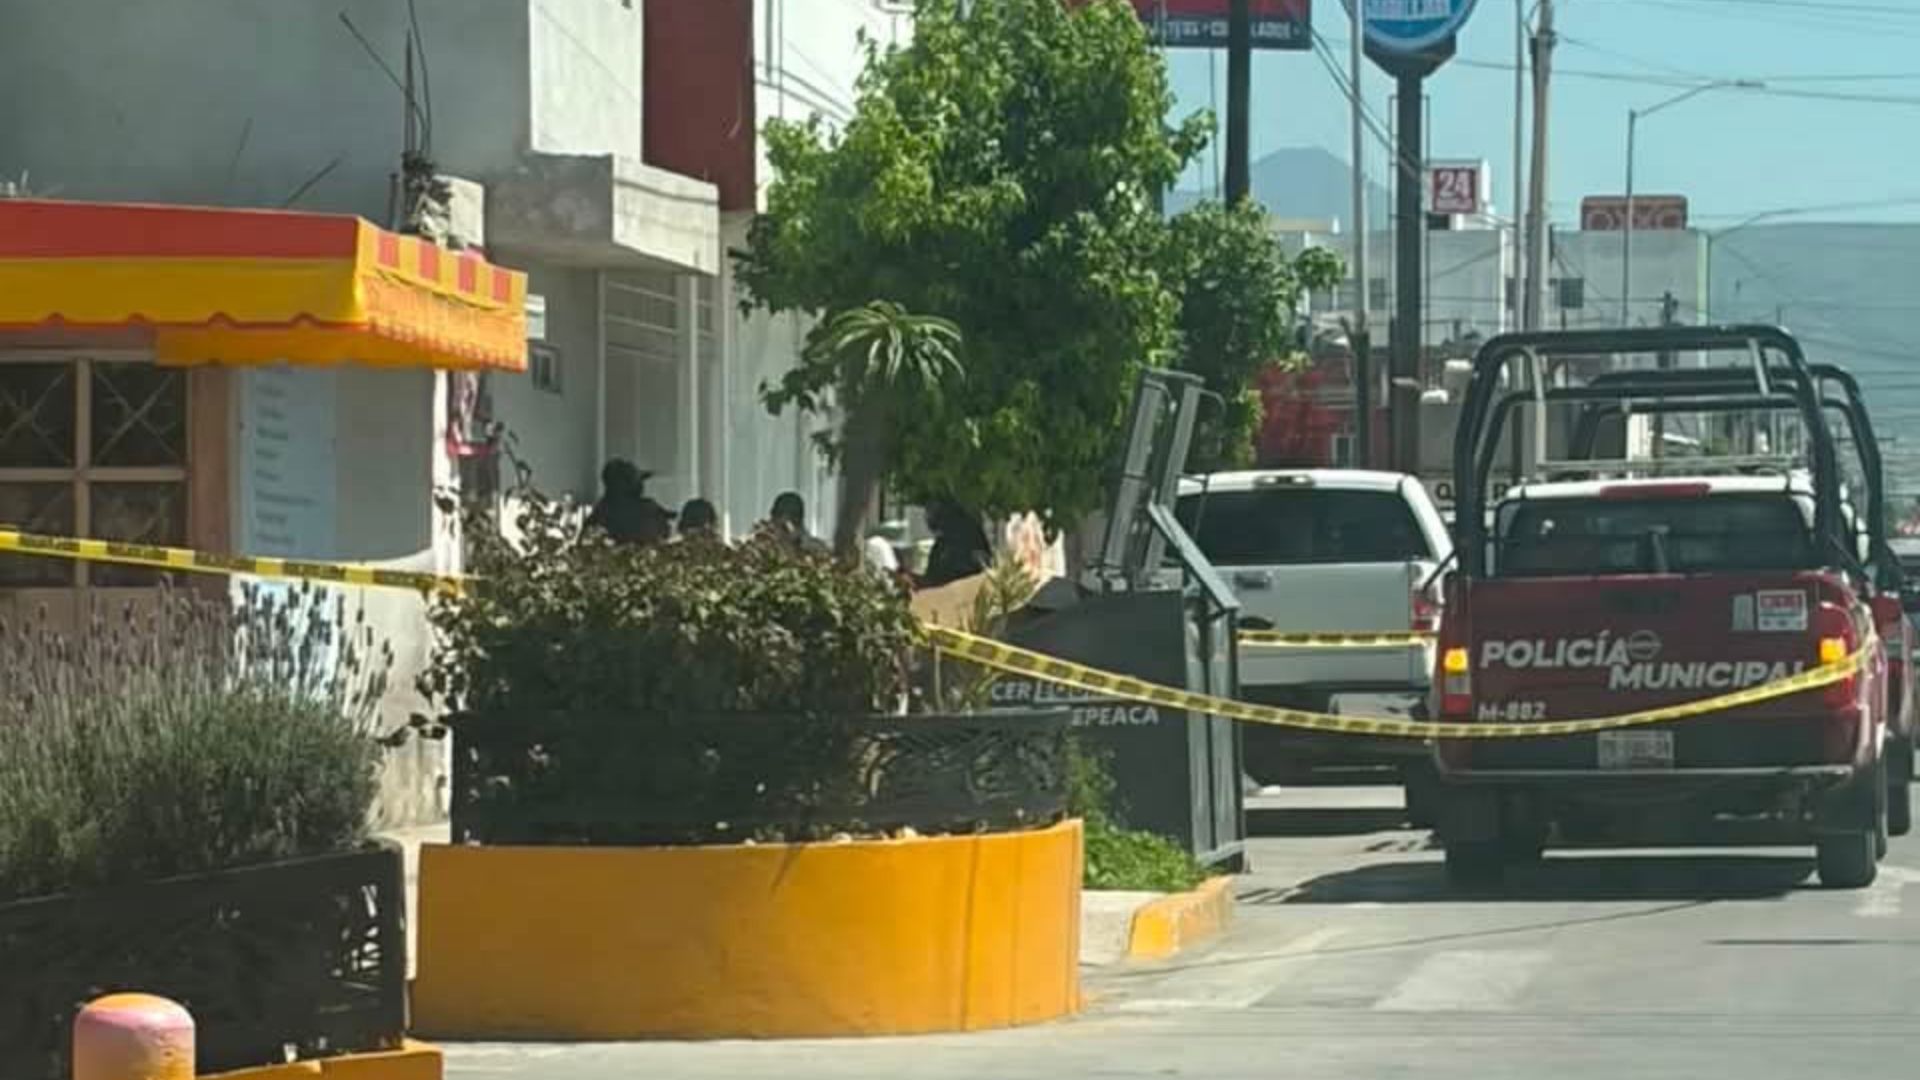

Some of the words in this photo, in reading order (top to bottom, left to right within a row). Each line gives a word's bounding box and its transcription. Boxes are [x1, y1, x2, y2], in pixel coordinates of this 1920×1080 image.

[1439, 170, 1471, 198] 24
[1479, 629, 1630, 668] POLICÍA
[1071, 705, 1160, 726] EPEACA
